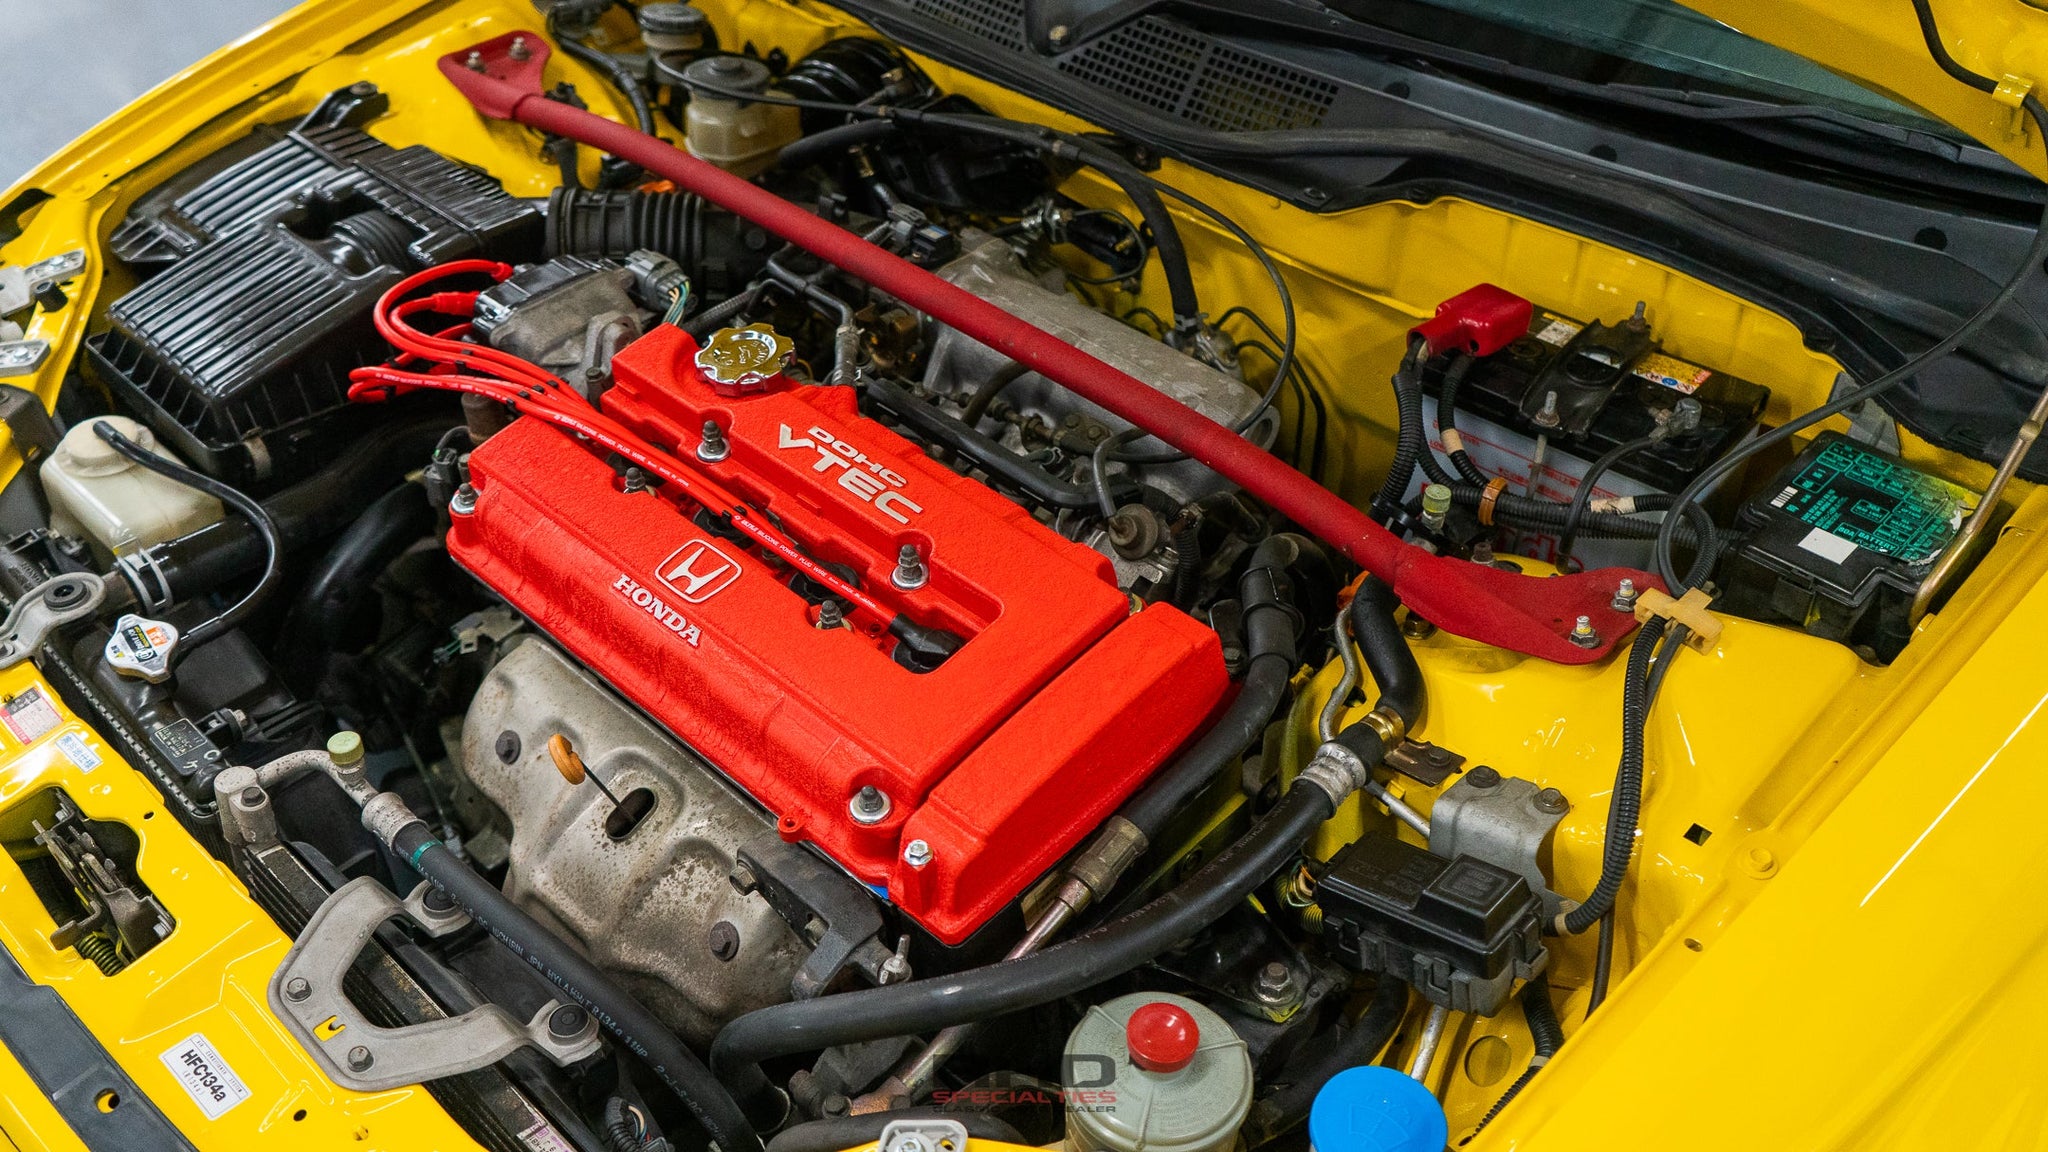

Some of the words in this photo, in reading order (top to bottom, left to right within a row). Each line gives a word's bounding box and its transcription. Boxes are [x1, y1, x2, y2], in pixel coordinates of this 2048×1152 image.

[597, 433, 617, 447] POWER
[616, 443, 631, 454] PLUG
[631, 451, 646, 462] WIRE
[809, 424, 909, 488] DOHC
[778, 423, 924, 526] VTEC
[756, 529, 780, 547] SILICONE
[778, 544, 799, 560] POWER
[798, 556, 813, 569] PLUG
[812, 565, 828, 578] WIRE
[1838, 526, 1855, 537] 80A
[1858, 530, 1897, 552] BATTERY
[613, 572, 701, 648] HONDA
[180, 1048, 227, 1102] HFC134a
